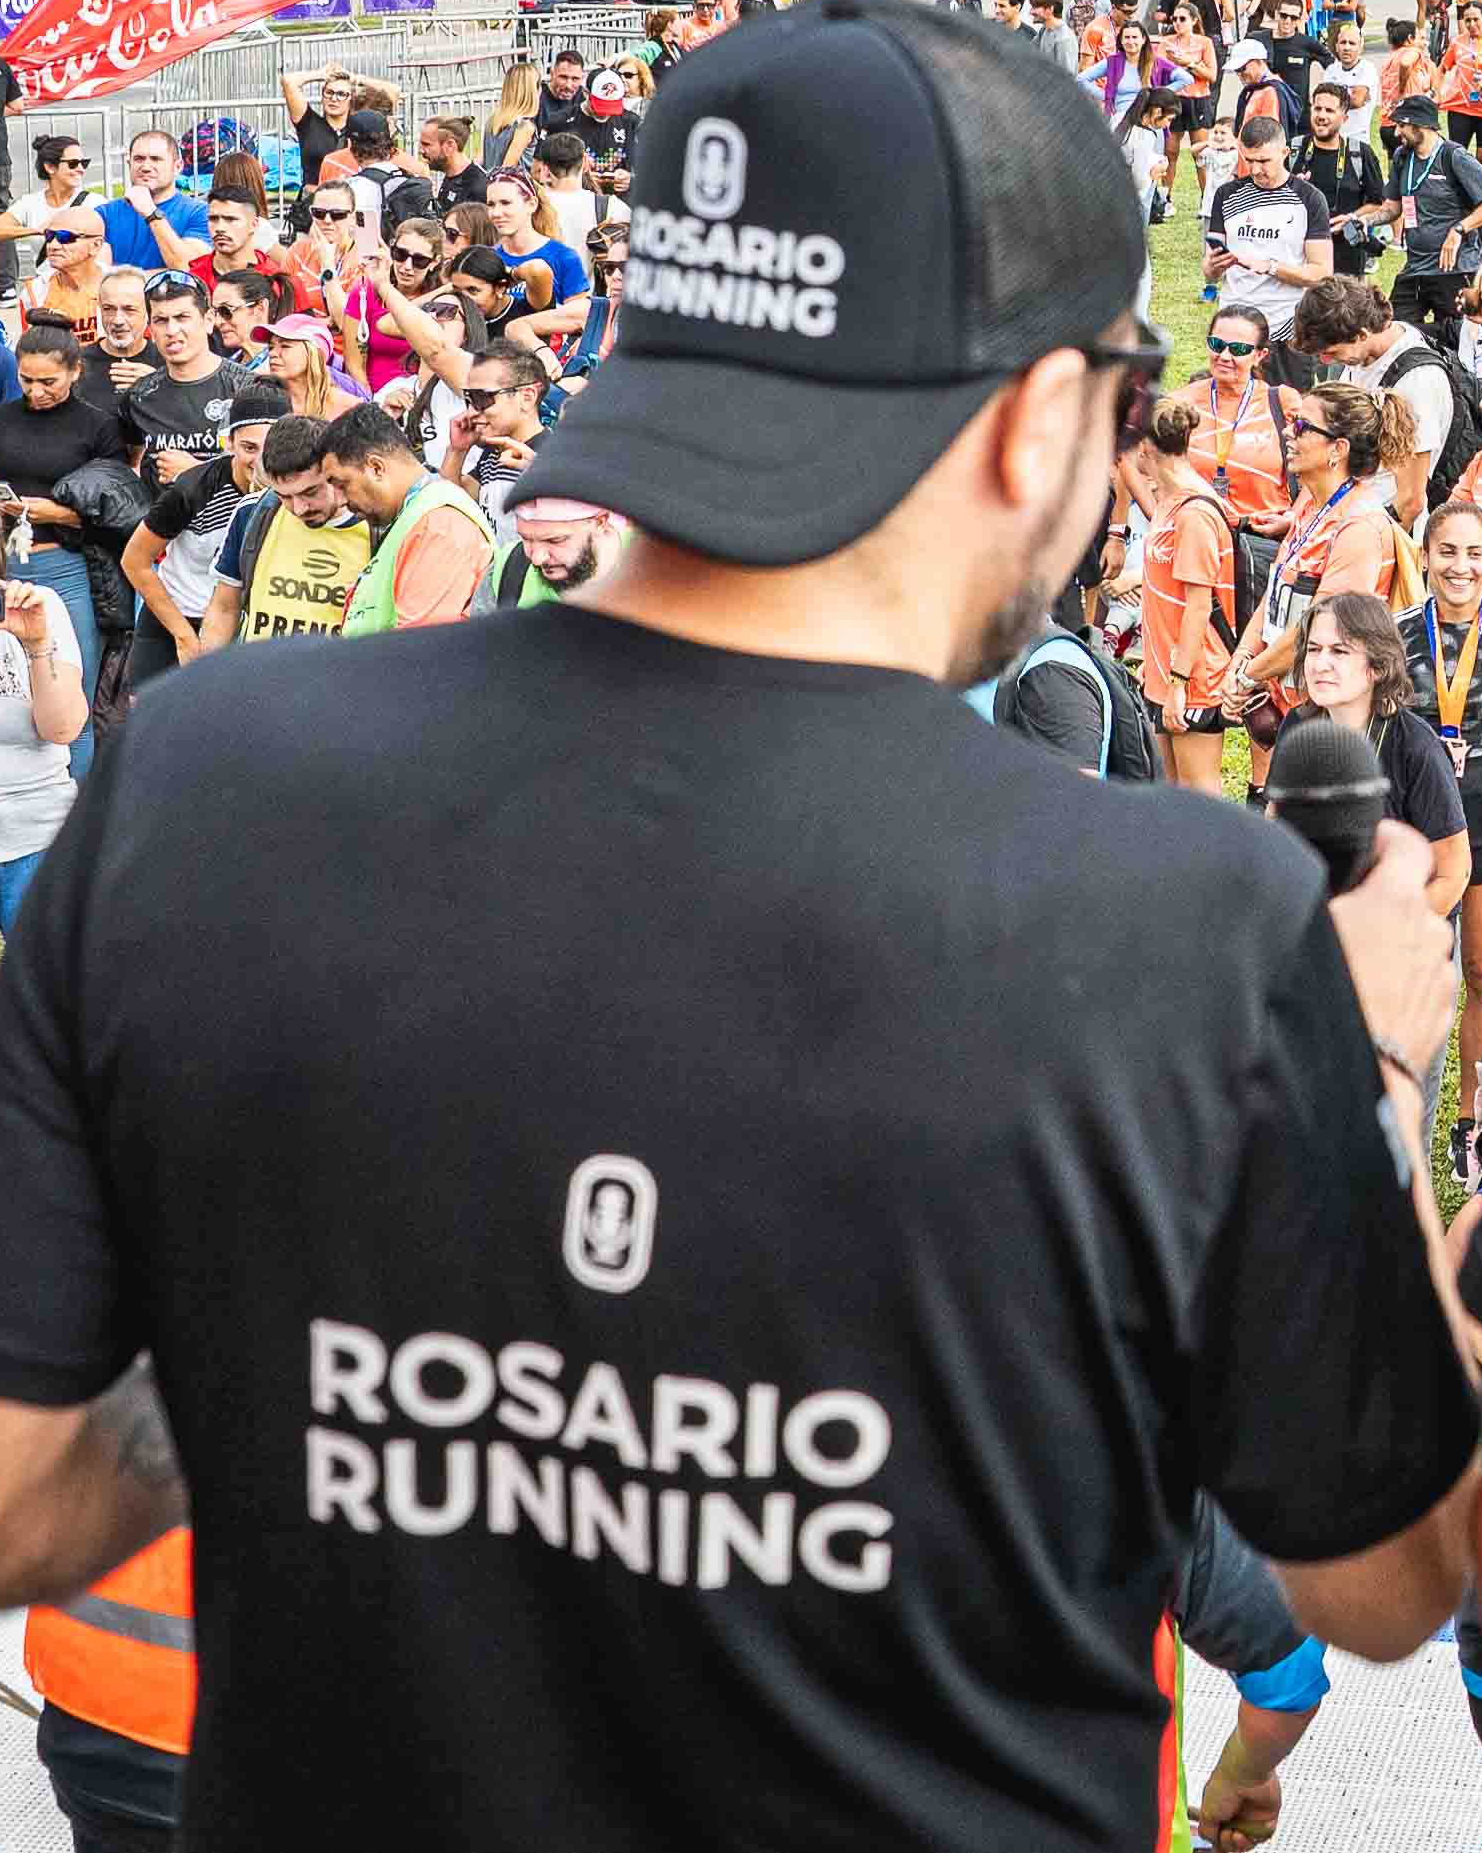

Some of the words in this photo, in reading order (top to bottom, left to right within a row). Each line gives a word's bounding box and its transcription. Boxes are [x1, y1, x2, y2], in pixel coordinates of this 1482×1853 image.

[630, 206, 845, 286] ROSARIO
[624, 258, 838, 337] RUNNING
[253, 612, 345, 638] PRENS
[268, 576, 348, 609] SONDE
[310, 1317, 892, 1488] ROSARIO
[306, 1425, 894, 1593] RUNNING
